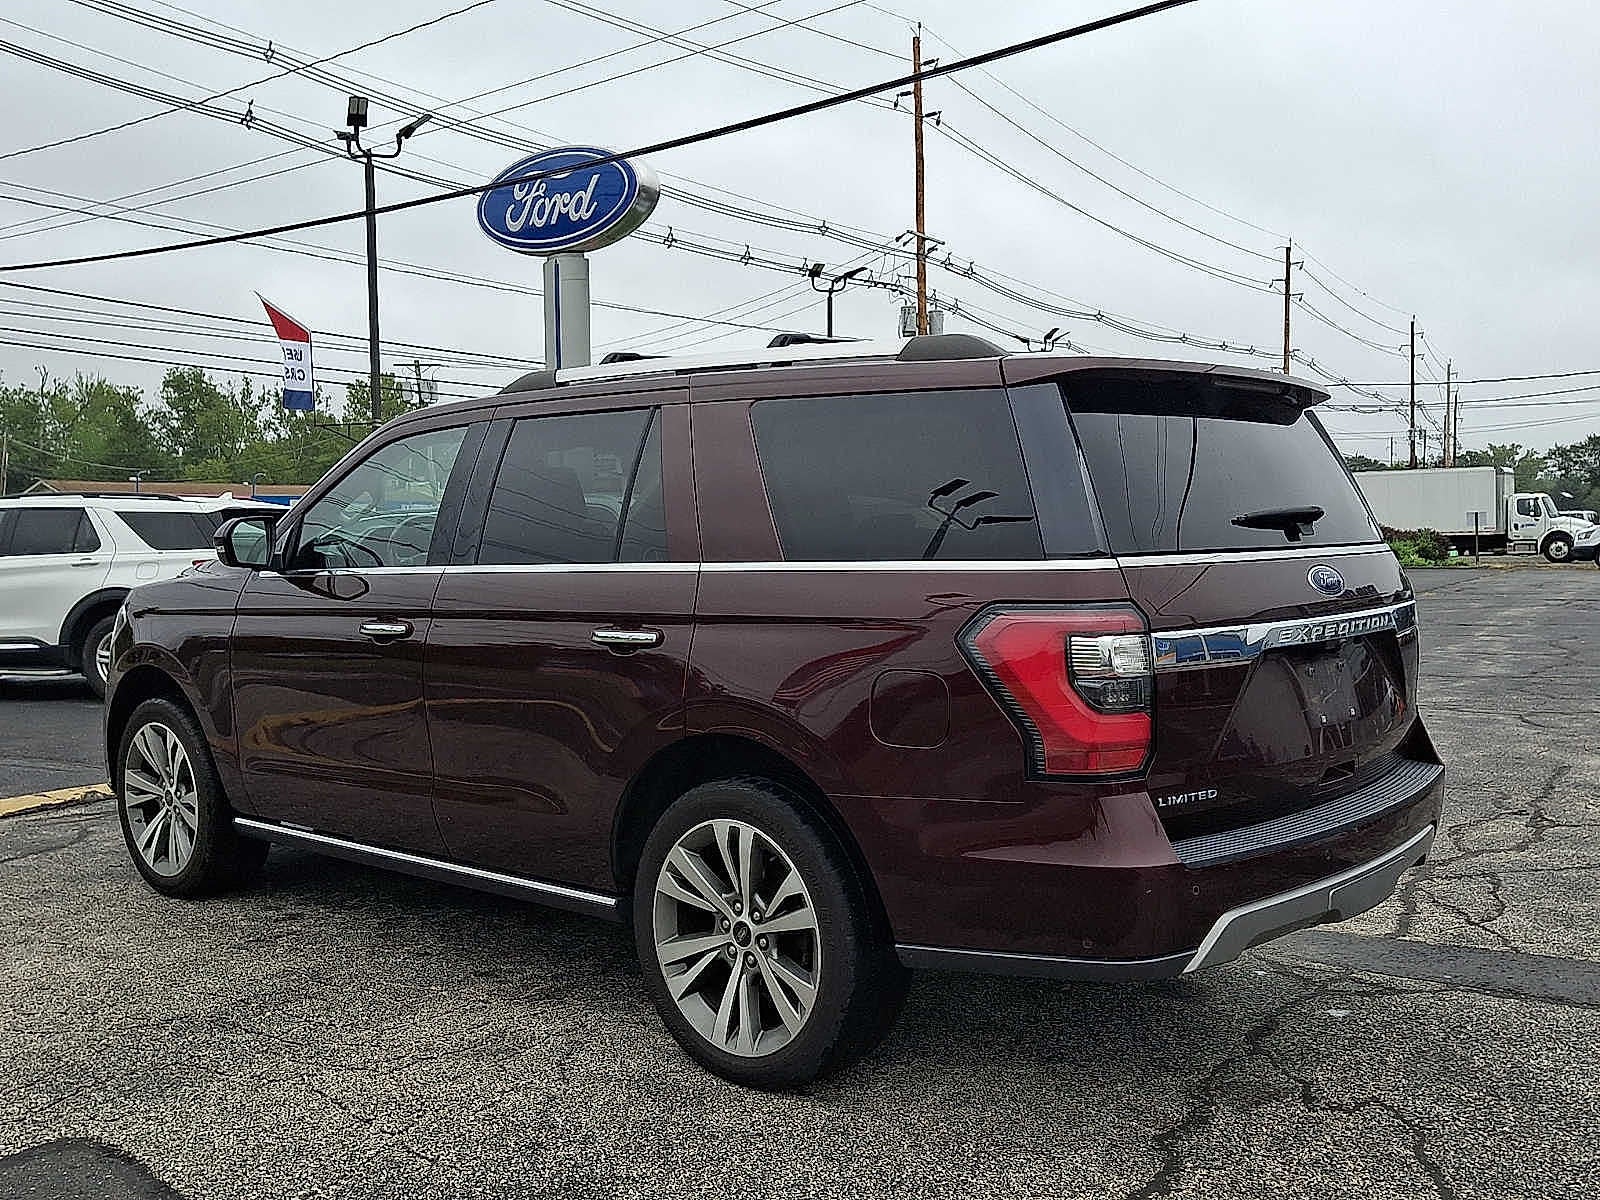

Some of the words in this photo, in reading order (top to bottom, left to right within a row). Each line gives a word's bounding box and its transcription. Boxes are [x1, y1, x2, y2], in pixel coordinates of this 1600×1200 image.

[505, 171, 600, 232] Ford
[1318, 571, 1341, 587] Ford
[1279, 613, 1389, 643] EXPEDITION
[1158, 789, 1218, 807] LIMITED
